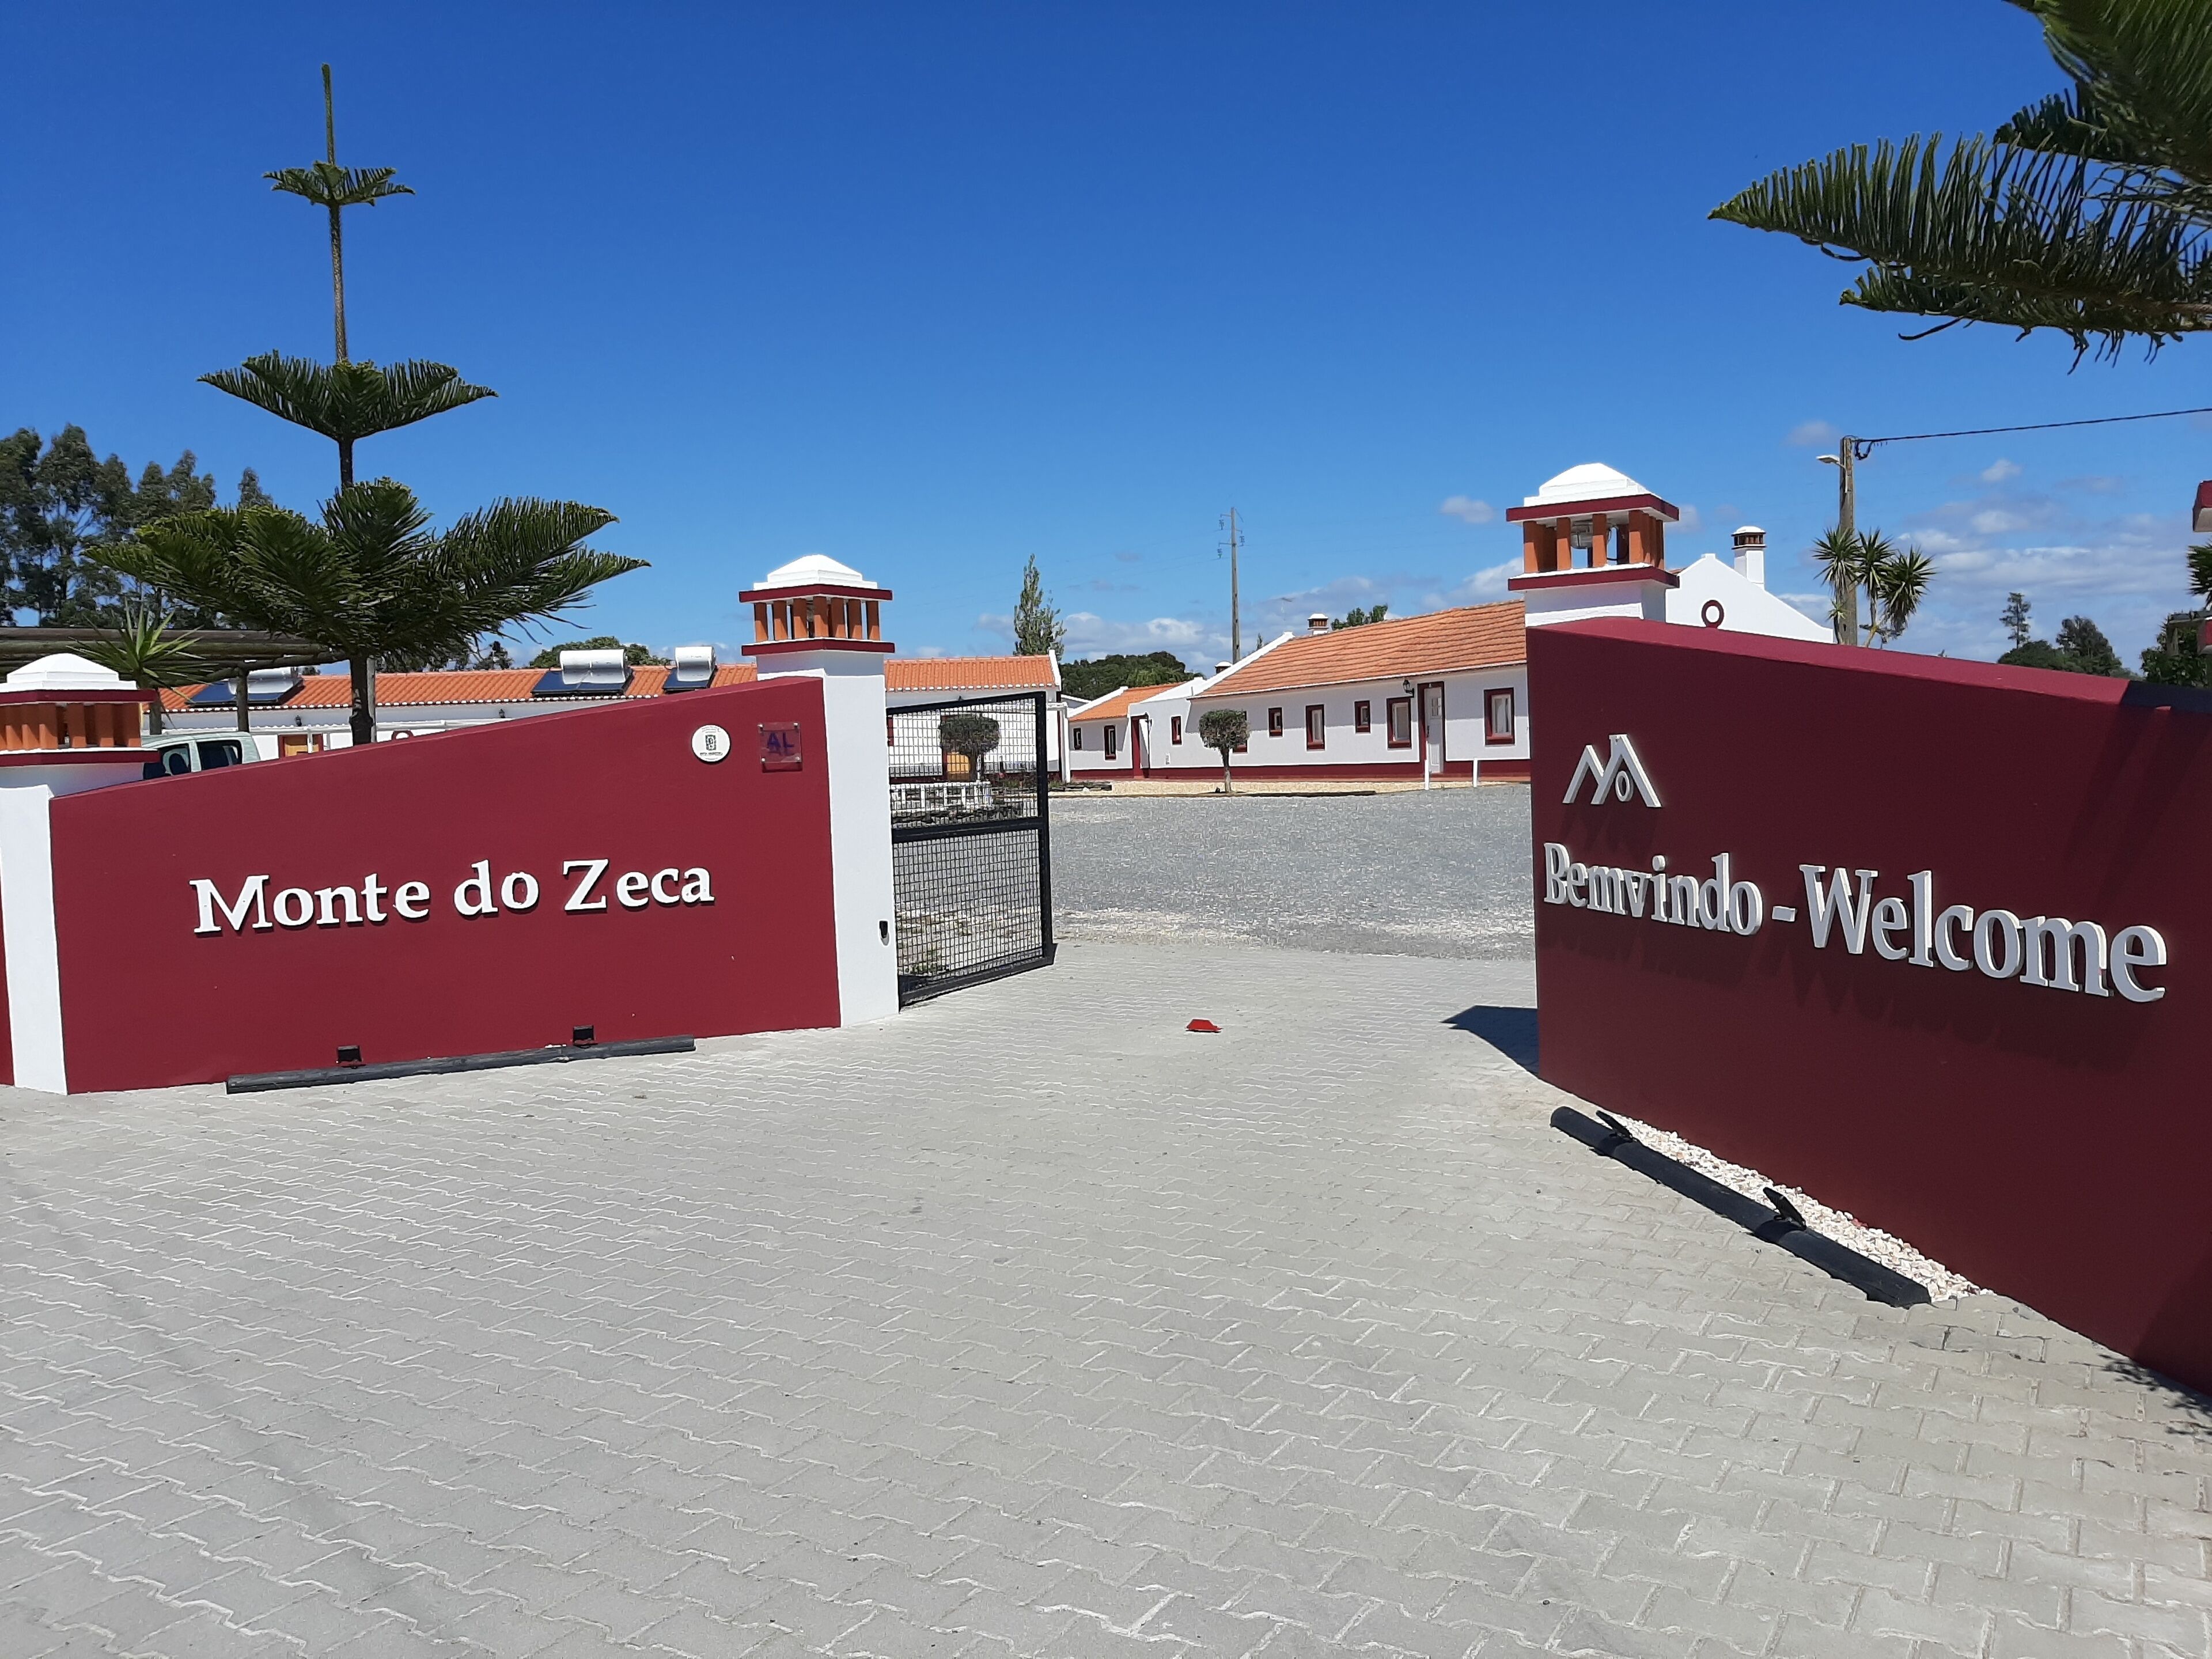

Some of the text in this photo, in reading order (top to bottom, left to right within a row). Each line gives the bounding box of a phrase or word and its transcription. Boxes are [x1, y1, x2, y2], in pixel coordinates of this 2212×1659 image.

[190, 858, 715, 934] Monte do Zeca
[1543, 842, 1763, 936] Bemvindo
[1799, 864, 2168, 1003] Welcome
